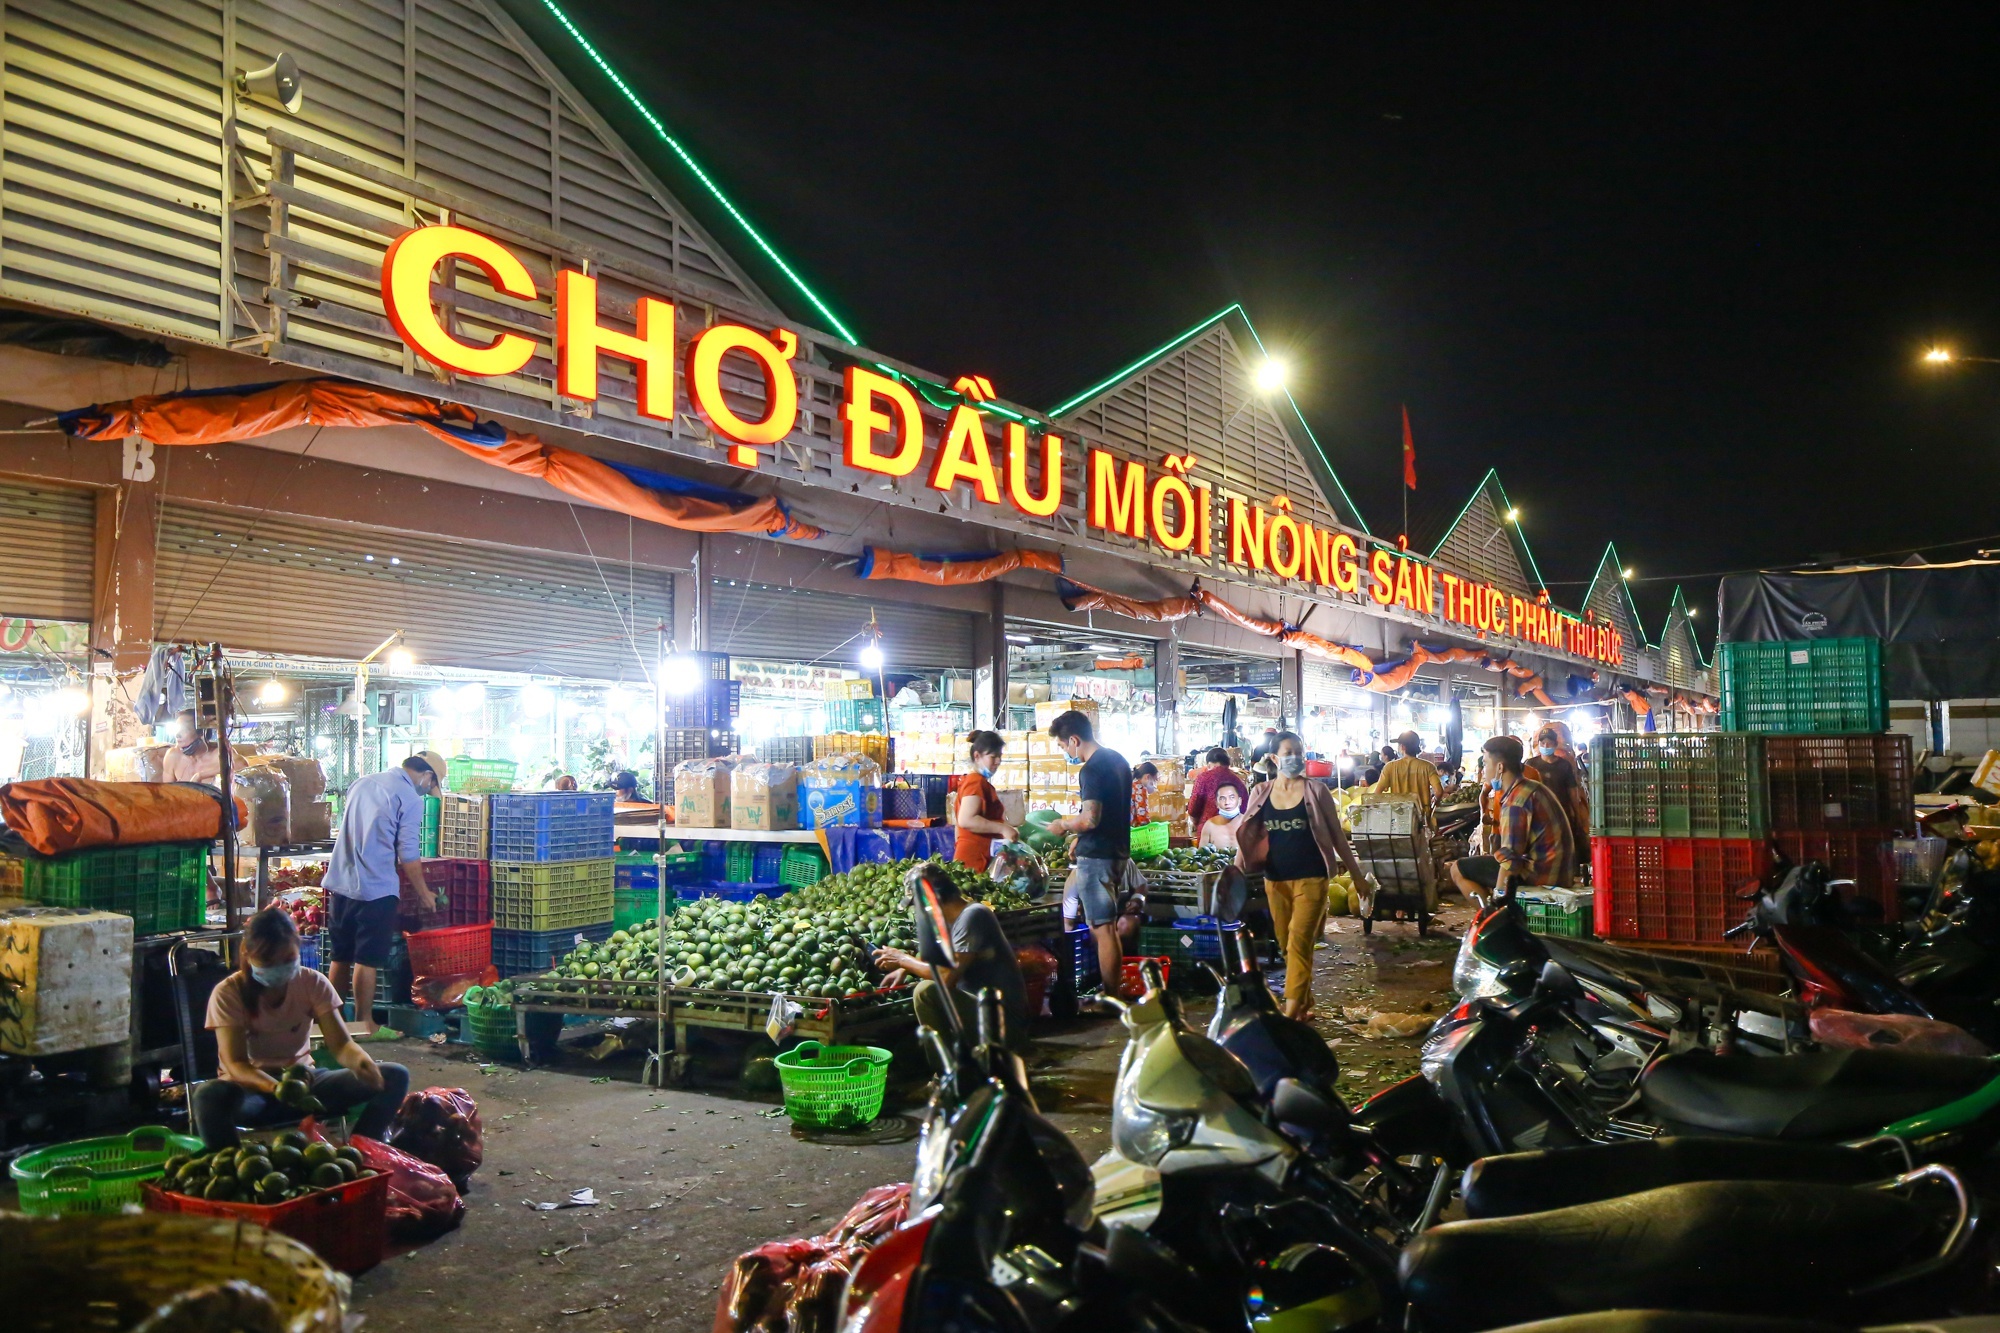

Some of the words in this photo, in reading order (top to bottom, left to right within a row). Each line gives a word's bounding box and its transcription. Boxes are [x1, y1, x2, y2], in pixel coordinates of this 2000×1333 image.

[122, 434, 156, 482] B
[381, 220, 799, 469] CHỢ
[842, 367, 1062, 517] ĐẦU
[1089, 448, 1212, 558] MỐI
[1227, 494, 1359, 594] NÔNG
[1370, 534, 1434, 614] SẢN
[1440, 573, 1507, 641] THỰC
[1508, 589, 1563, 649] PHẨM
[1566, 609, 1597, 660] THỦ
[1597, 620, 1624, 666] ĐỨC
